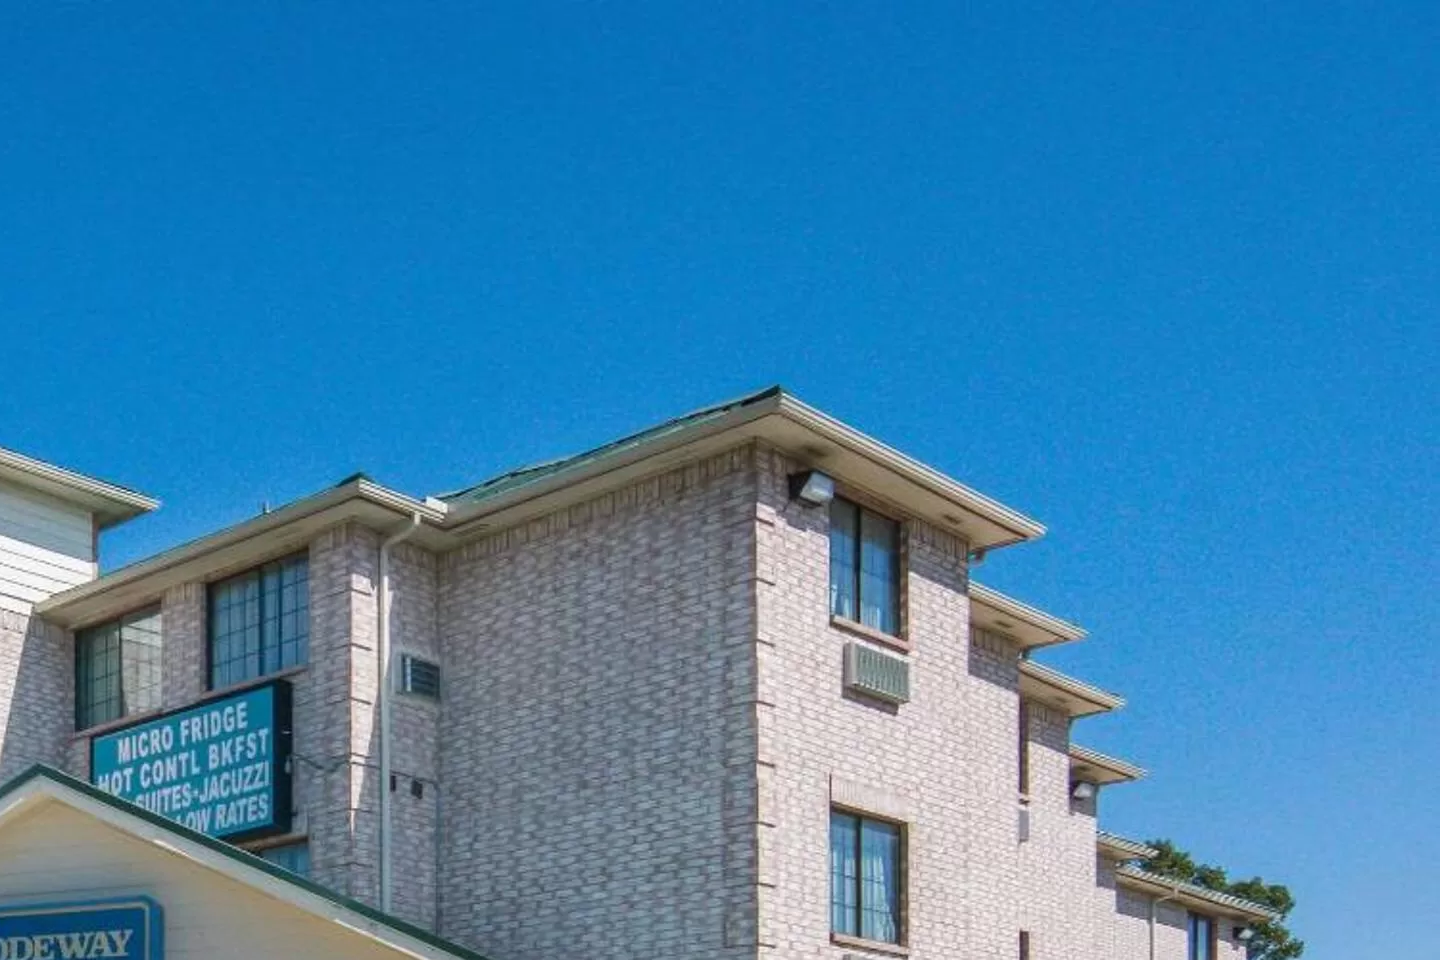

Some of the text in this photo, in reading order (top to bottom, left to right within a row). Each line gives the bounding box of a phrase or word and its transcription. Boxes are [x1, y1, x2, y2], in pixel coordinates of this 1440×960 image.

[97, 728, 269, 797] HOT CONTL BKFST
[118, 702, 248, 764] MICRO FRIDGE
[215, 794, 269, 831] RATES
